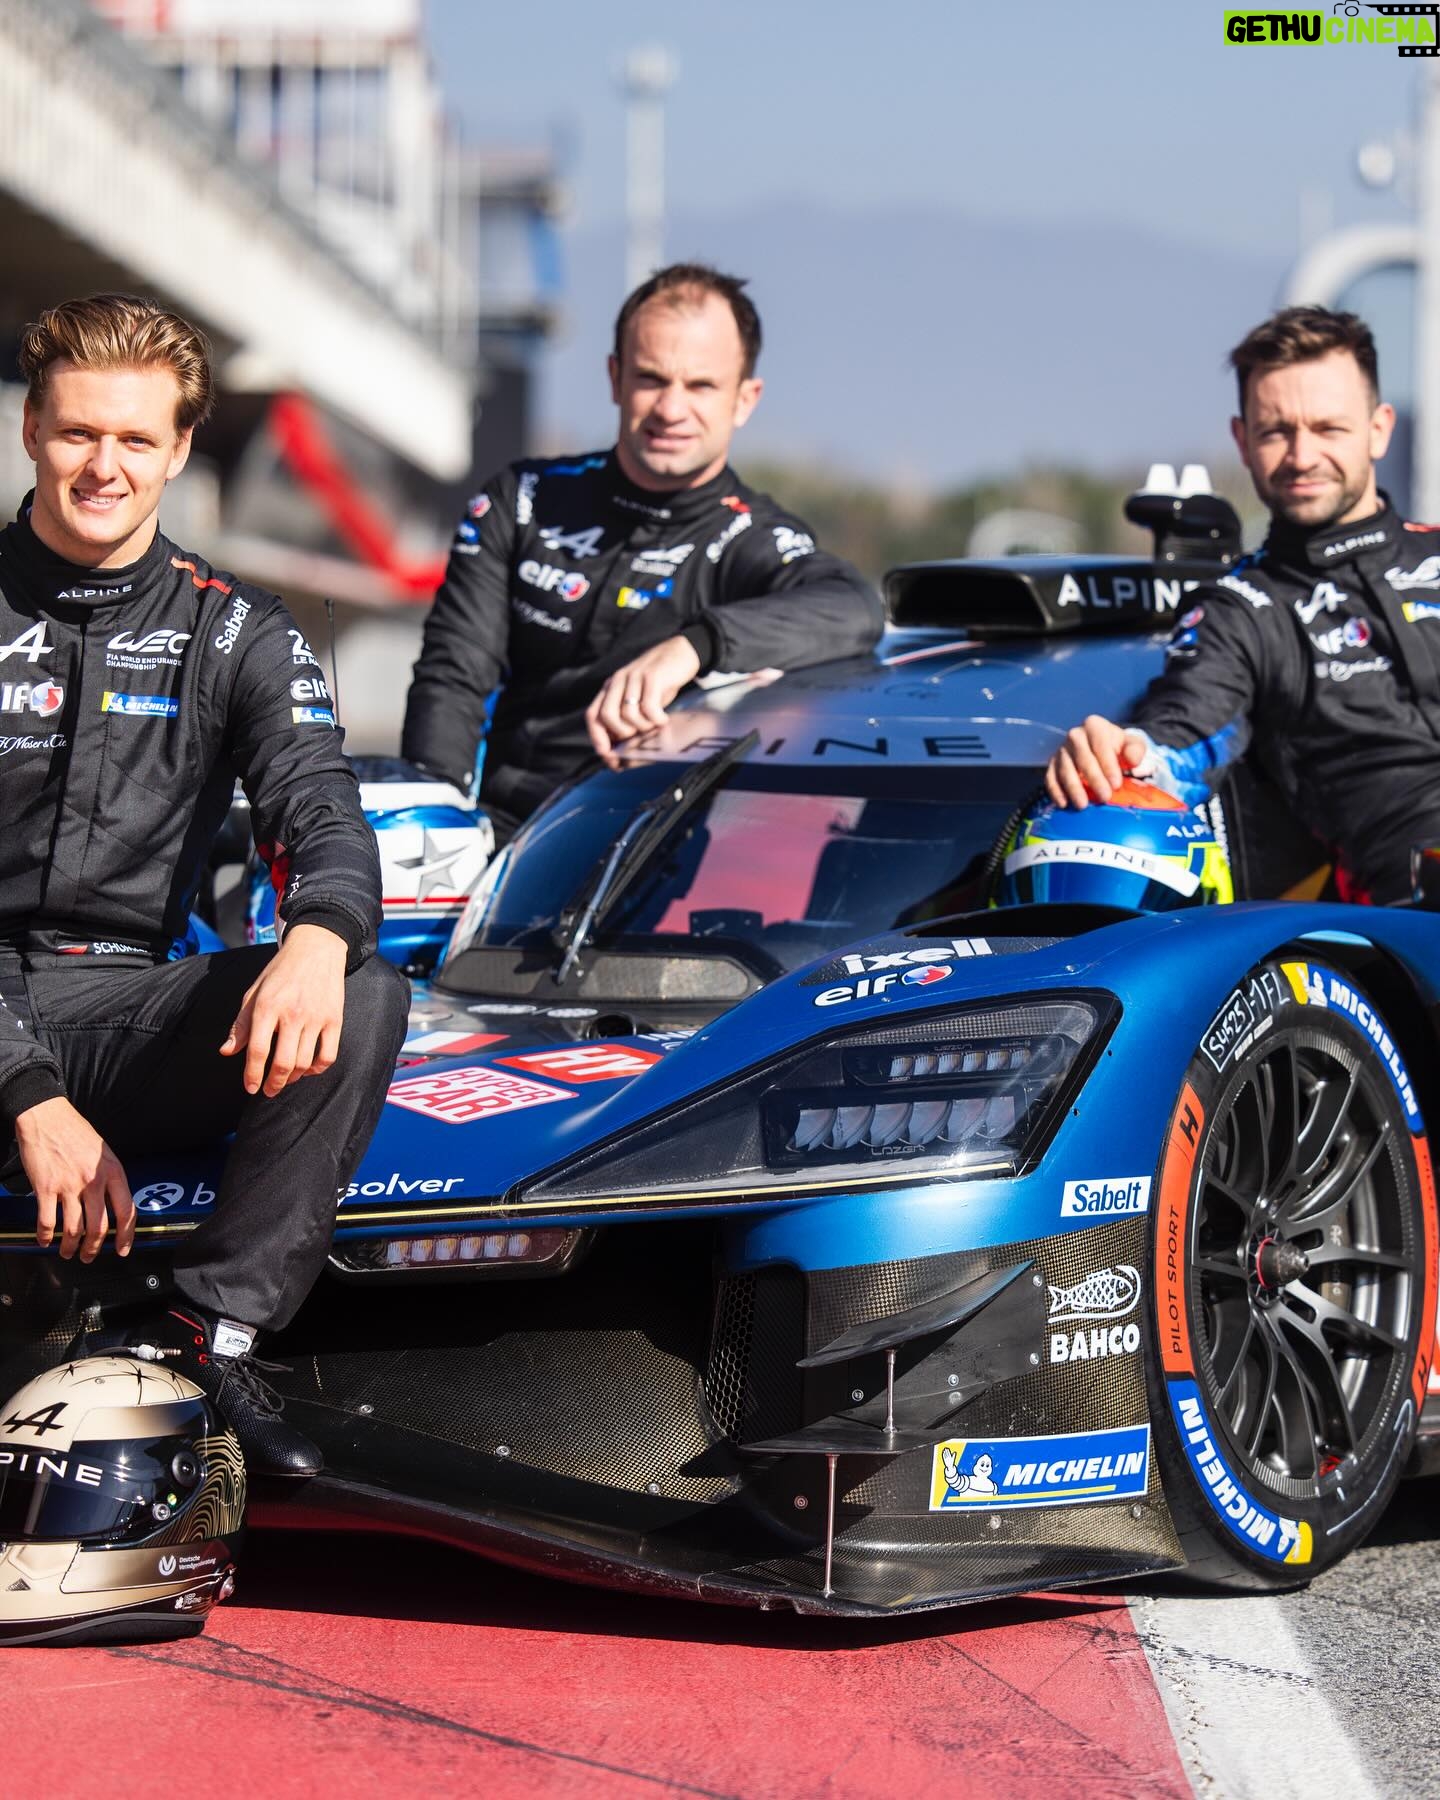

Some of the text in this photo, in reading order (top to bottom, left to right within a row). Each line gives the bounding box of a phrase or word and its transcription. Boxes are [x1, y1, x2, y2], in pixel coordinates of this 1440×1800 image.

[57, 583, 134, 599] ALPINE
[215, 597, 252, 654] Sabelt
[106, 660, 157, 670] CHAMPIONSHIP
[120, 655, 141, 664] WORLD
[841, 938, 993, 975] ixell
[814, 974, 898, 1006] elf
[1330, 979, 1419, 1116] MICHELIN
[388, 1080, 512, 1118] CAR
[440, 1070, 557, 1102] HYPER
[1072, 1182, 1142, 1213] Sabelt
[1168, 1205, 1182, 1354] PILOT SPORT
[1050, 1324, 1140, 1363] BAHCO
[1002, 1451, 1145, 1487] MICHELIN
[1178, 1397, 1277, 1546] MICHELIN
